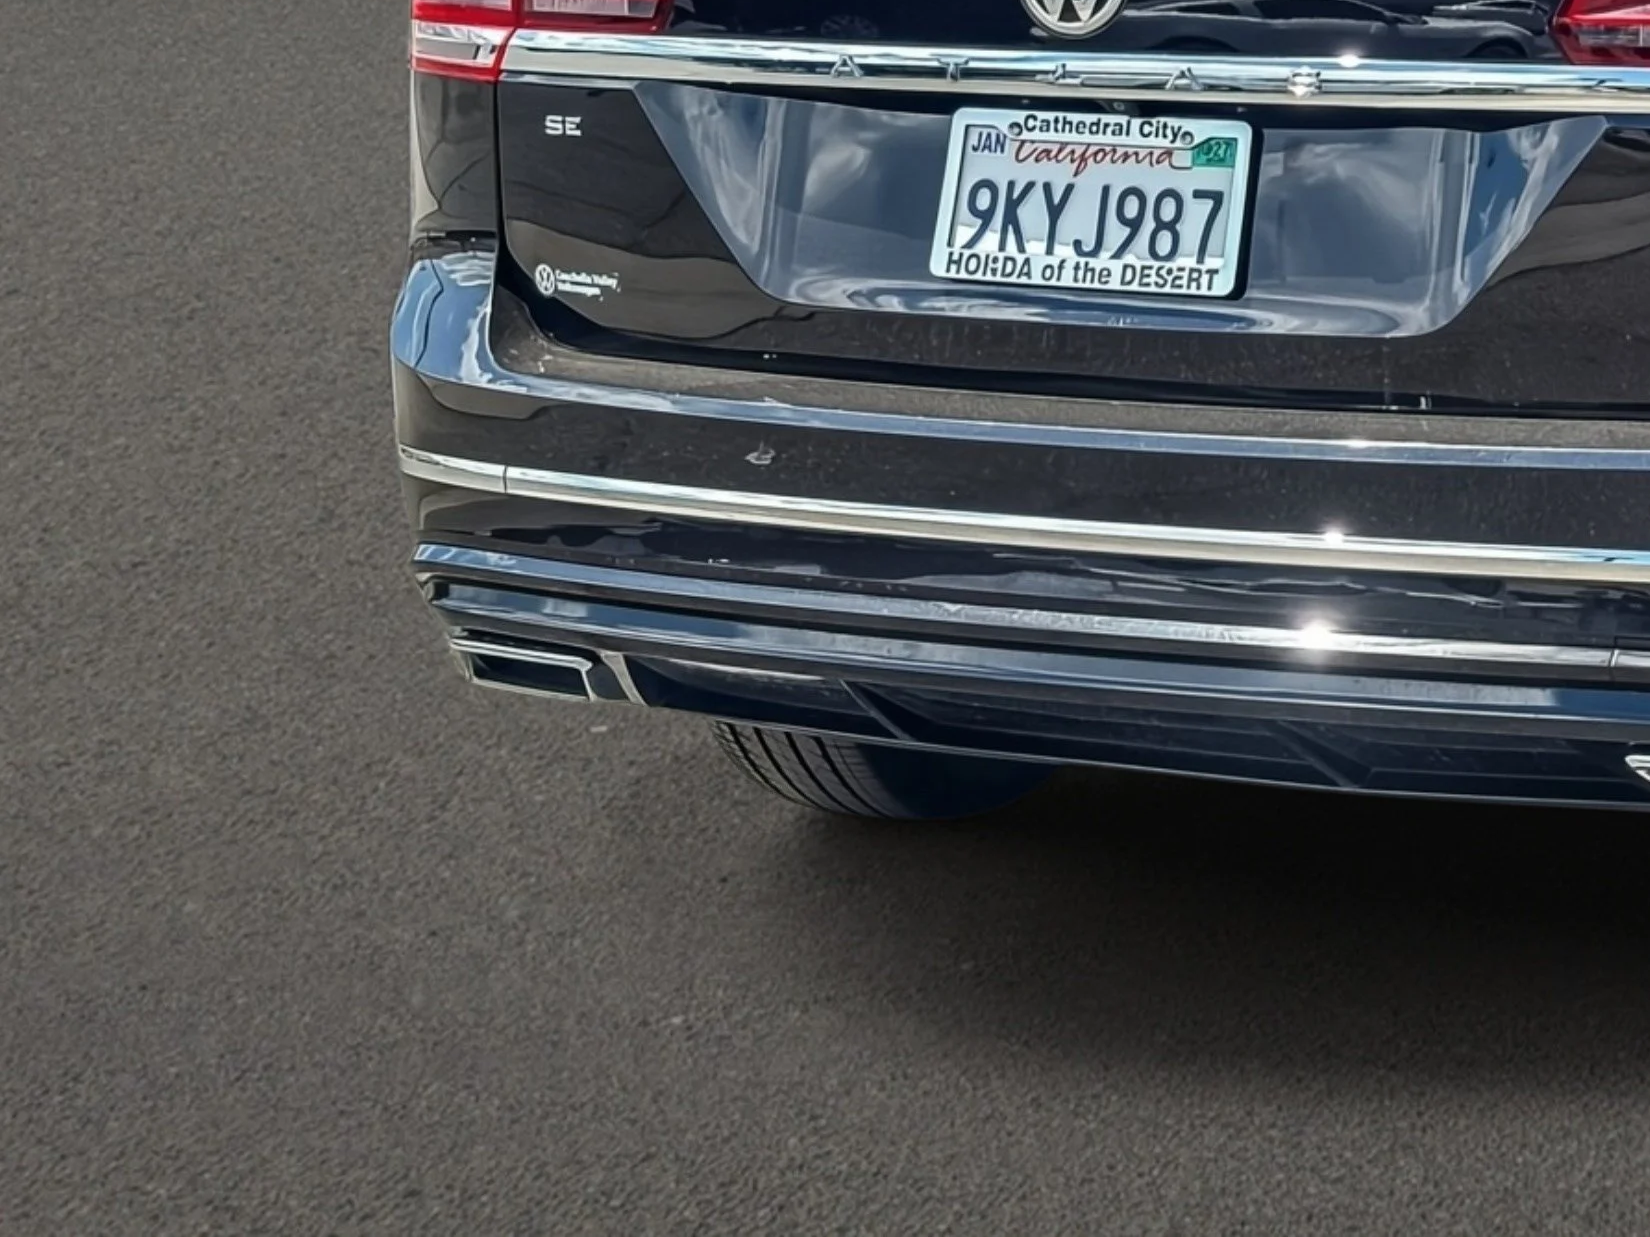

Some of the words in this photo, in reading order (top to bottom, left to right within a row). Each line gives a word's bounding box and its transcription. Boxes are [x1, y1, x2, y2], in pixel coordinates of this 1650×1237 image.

[544, 114, 582, 137] SE
[971, 130, 1007, 154] JAN
[1023, 114, 1131, 138] Cathedral
[1138, 120, 1182, 144] City
[1014, 140, 1174, 178] California
[960, 178, 1225, 265] 9KYJ987
[945, 252, 1032, 280] HONDA
[1040, 260, 1063, 282] of
[1072, 261, 1112, 285] the
[1120, 264, 1220, 291] DESERT
